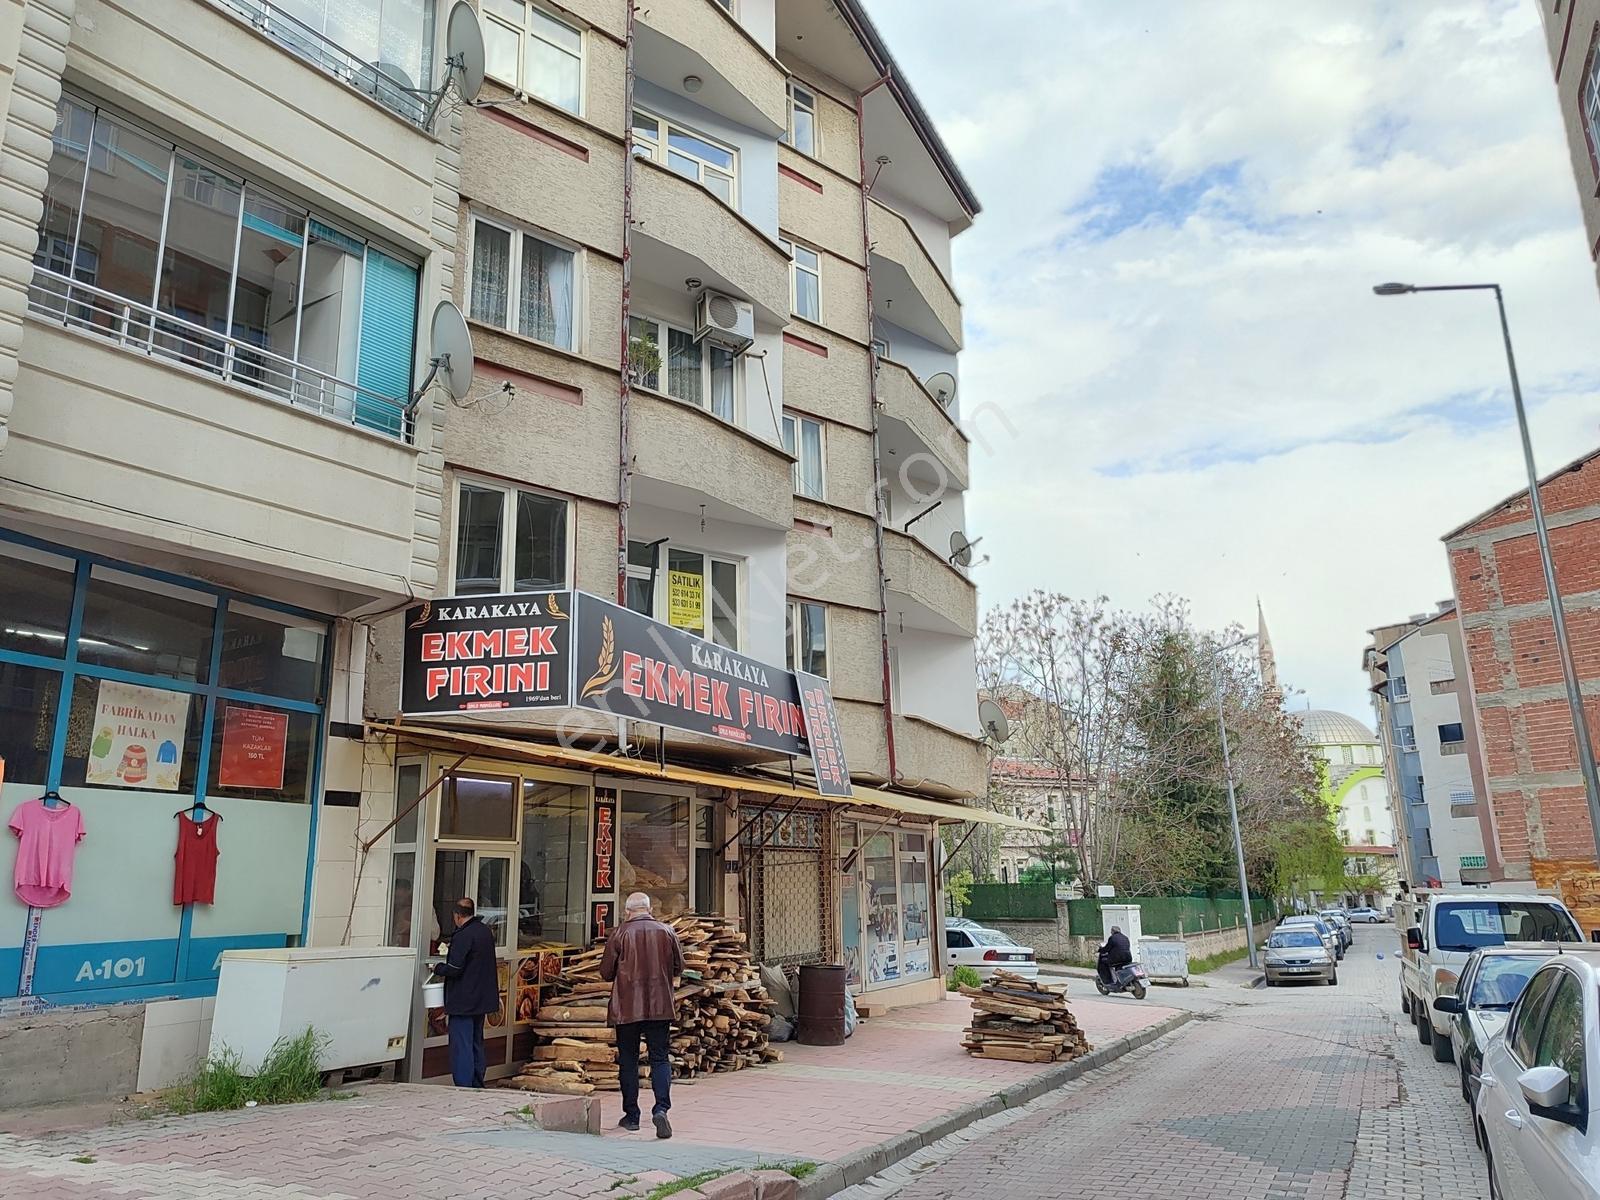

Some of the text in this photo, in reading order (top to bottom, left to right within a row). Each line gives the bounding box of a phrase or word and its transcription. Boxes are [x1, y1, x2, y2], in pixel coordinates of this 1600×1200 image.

[672, 574, 700, 588] SATILIK
[438, 602, 541, 621] KARAKAYA
[421, 625, 558, 662] EKMEK
[426, 661, 550, 701] FIRINI
[622, 650, 733, 721] EKMEK
[690, 643, 769, 689] KARAKAYA
[101, 703, 176, 724] FABRİKADAN
[117, 725, 156, 740] HALKA
[804, 690, 831, 780] FIRINI
[813, 688, 842, 787] EKMEK
[596, 807, 612, 888] EKMEK
